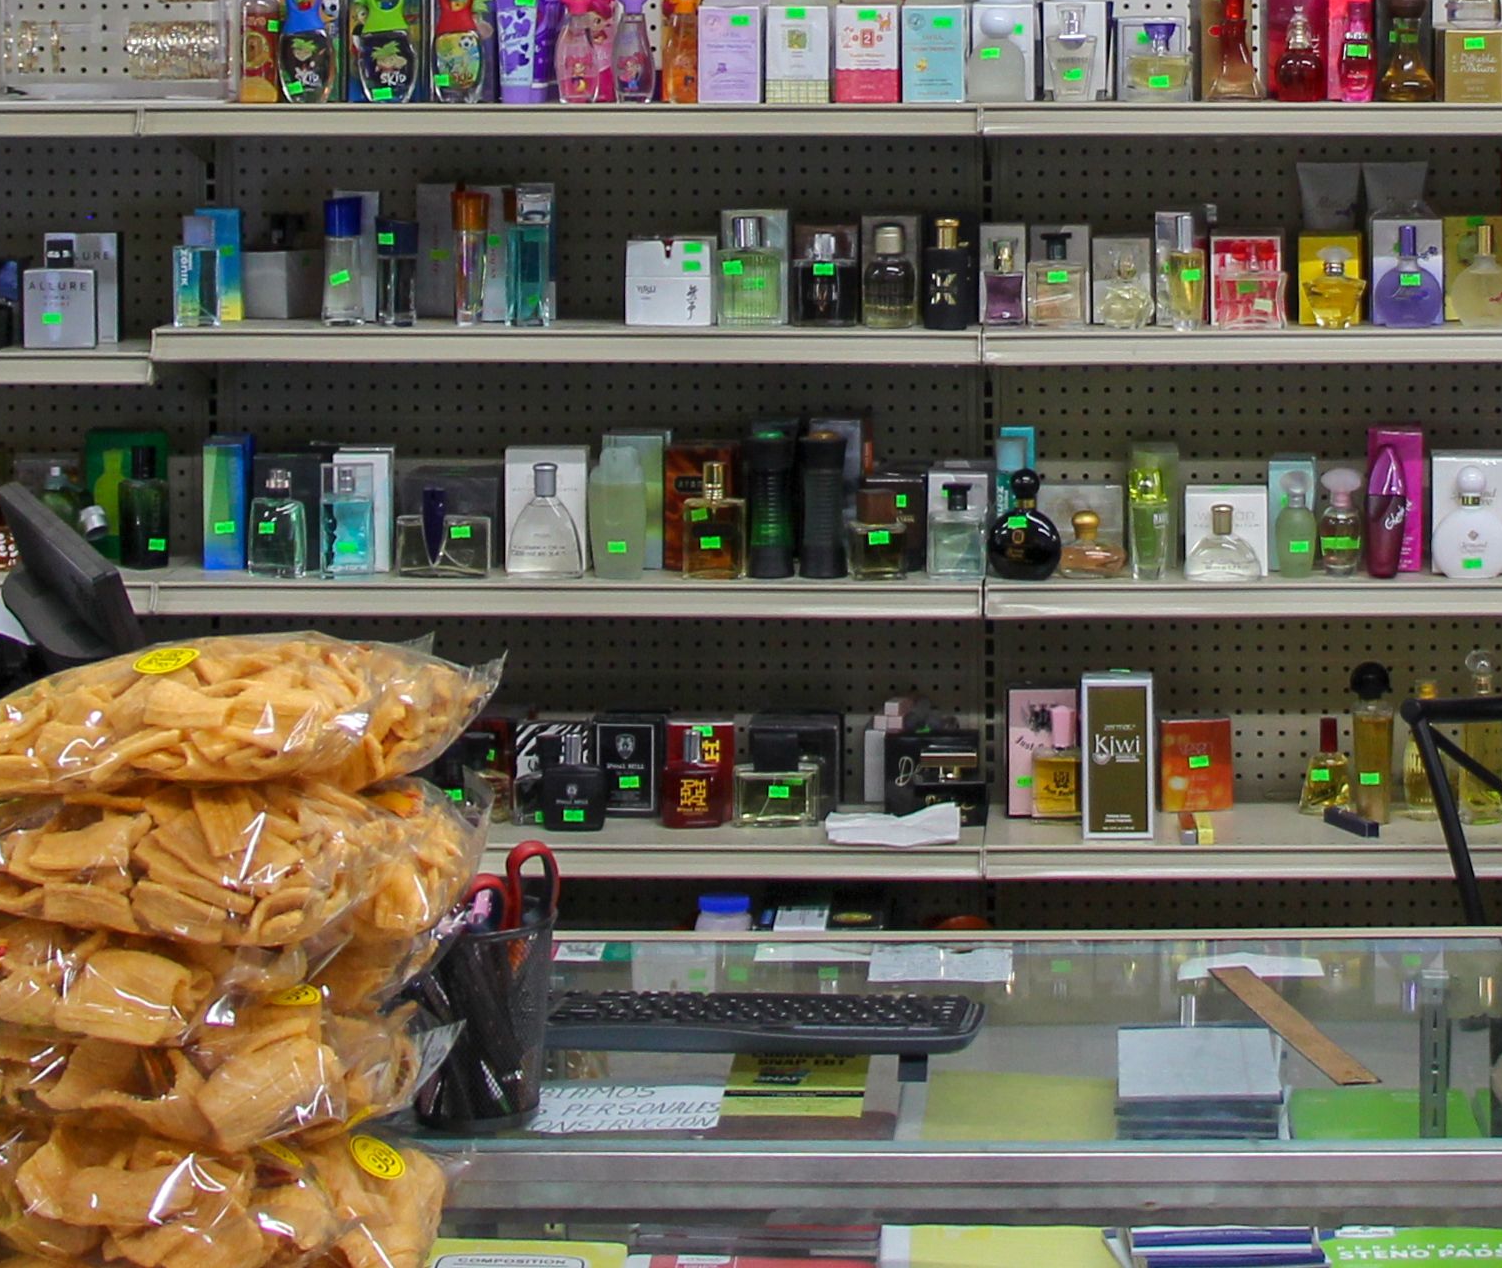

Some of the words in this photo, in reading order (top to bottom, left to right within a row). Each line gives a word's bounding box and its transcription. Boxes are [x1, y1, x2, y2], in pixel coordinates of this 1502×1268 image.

[1094, 734, 1141, 757] Kiwi
[562, 1100, 722, 1116] PERSONALES
[530, 1115, 717, 1132] ONSTRUCCION
[457, 1257, 567, 1266] COMPOSITION
[1338, 1248, 1435, 1260] STENO
